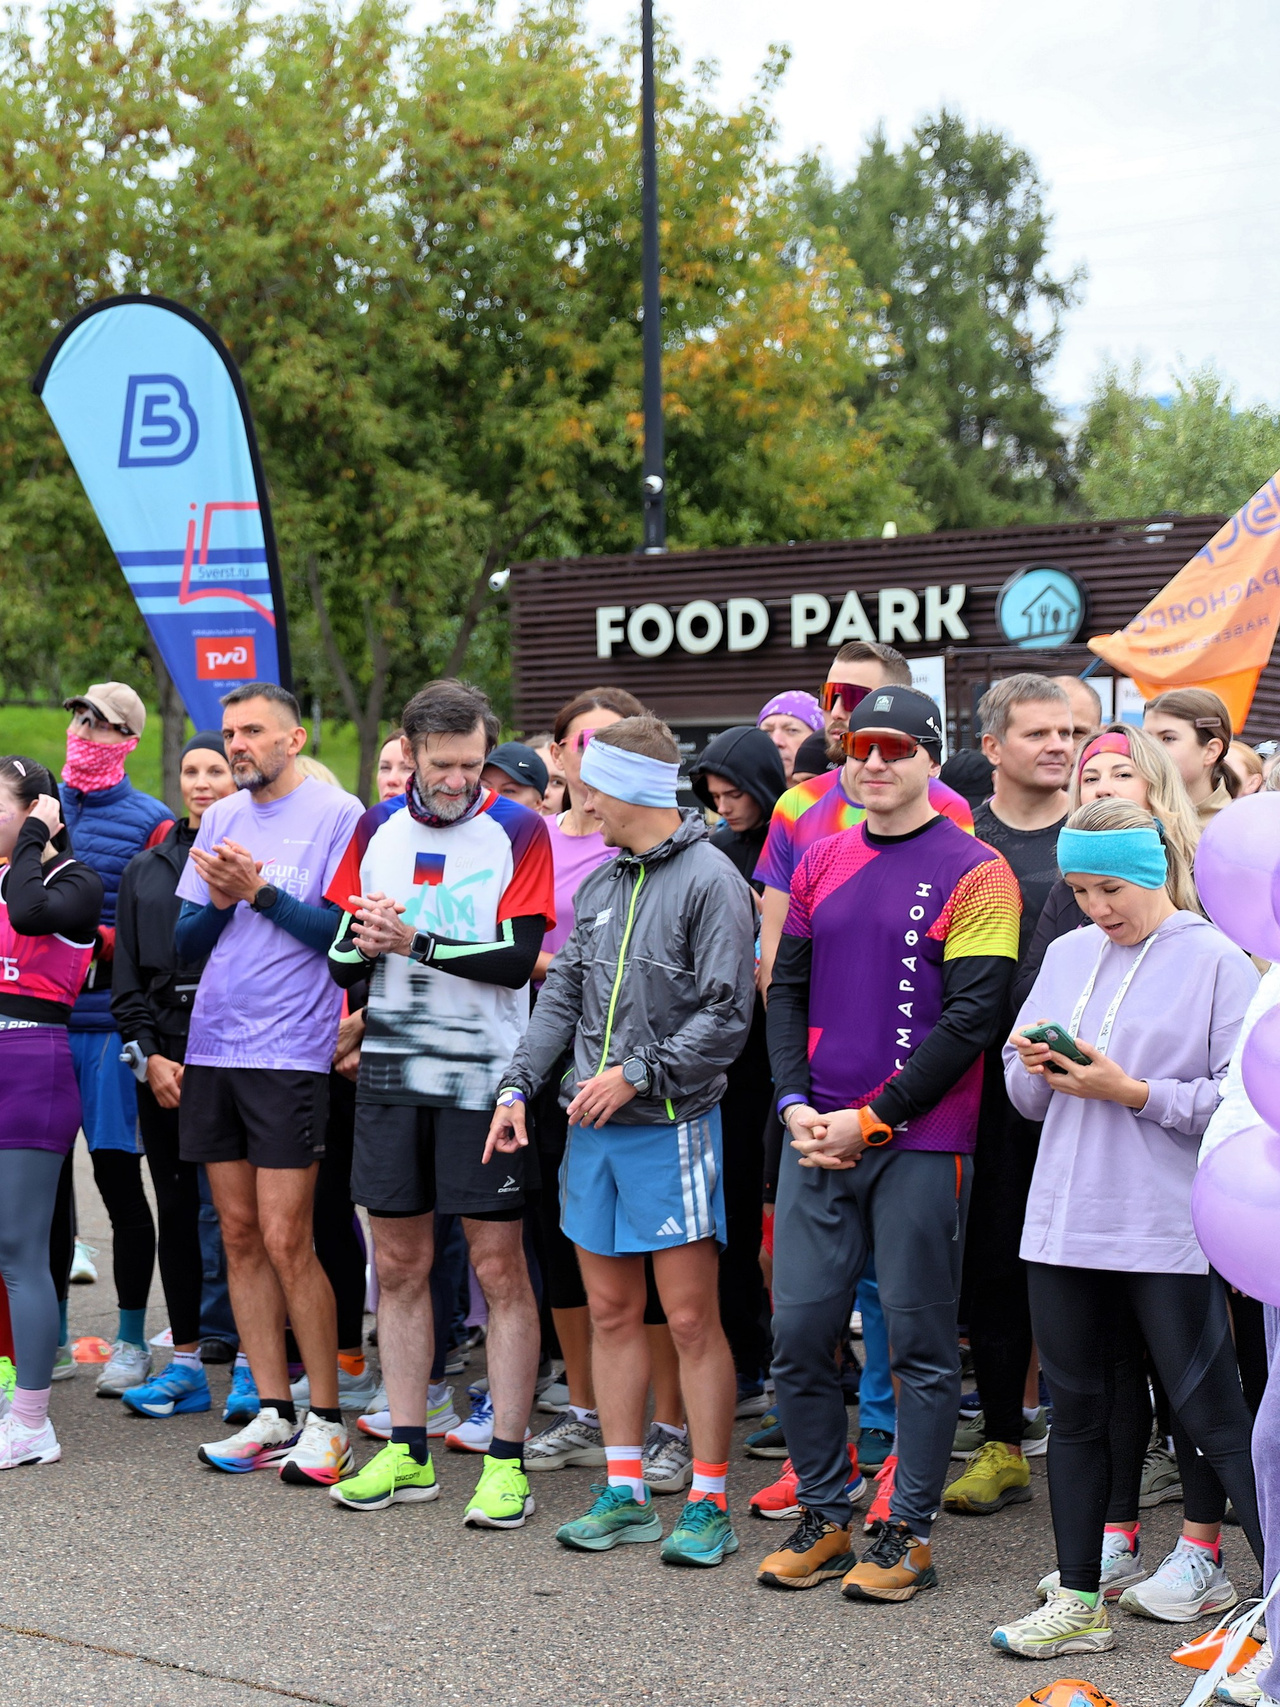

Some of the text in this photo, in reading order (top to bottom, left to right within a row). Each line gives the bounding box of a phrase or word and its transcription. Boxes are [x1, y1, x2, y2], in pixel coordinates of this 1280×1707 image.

[198, 565, 250, 579] 5verst.ru
[596, 583, 970, 659] FOOD PARK
